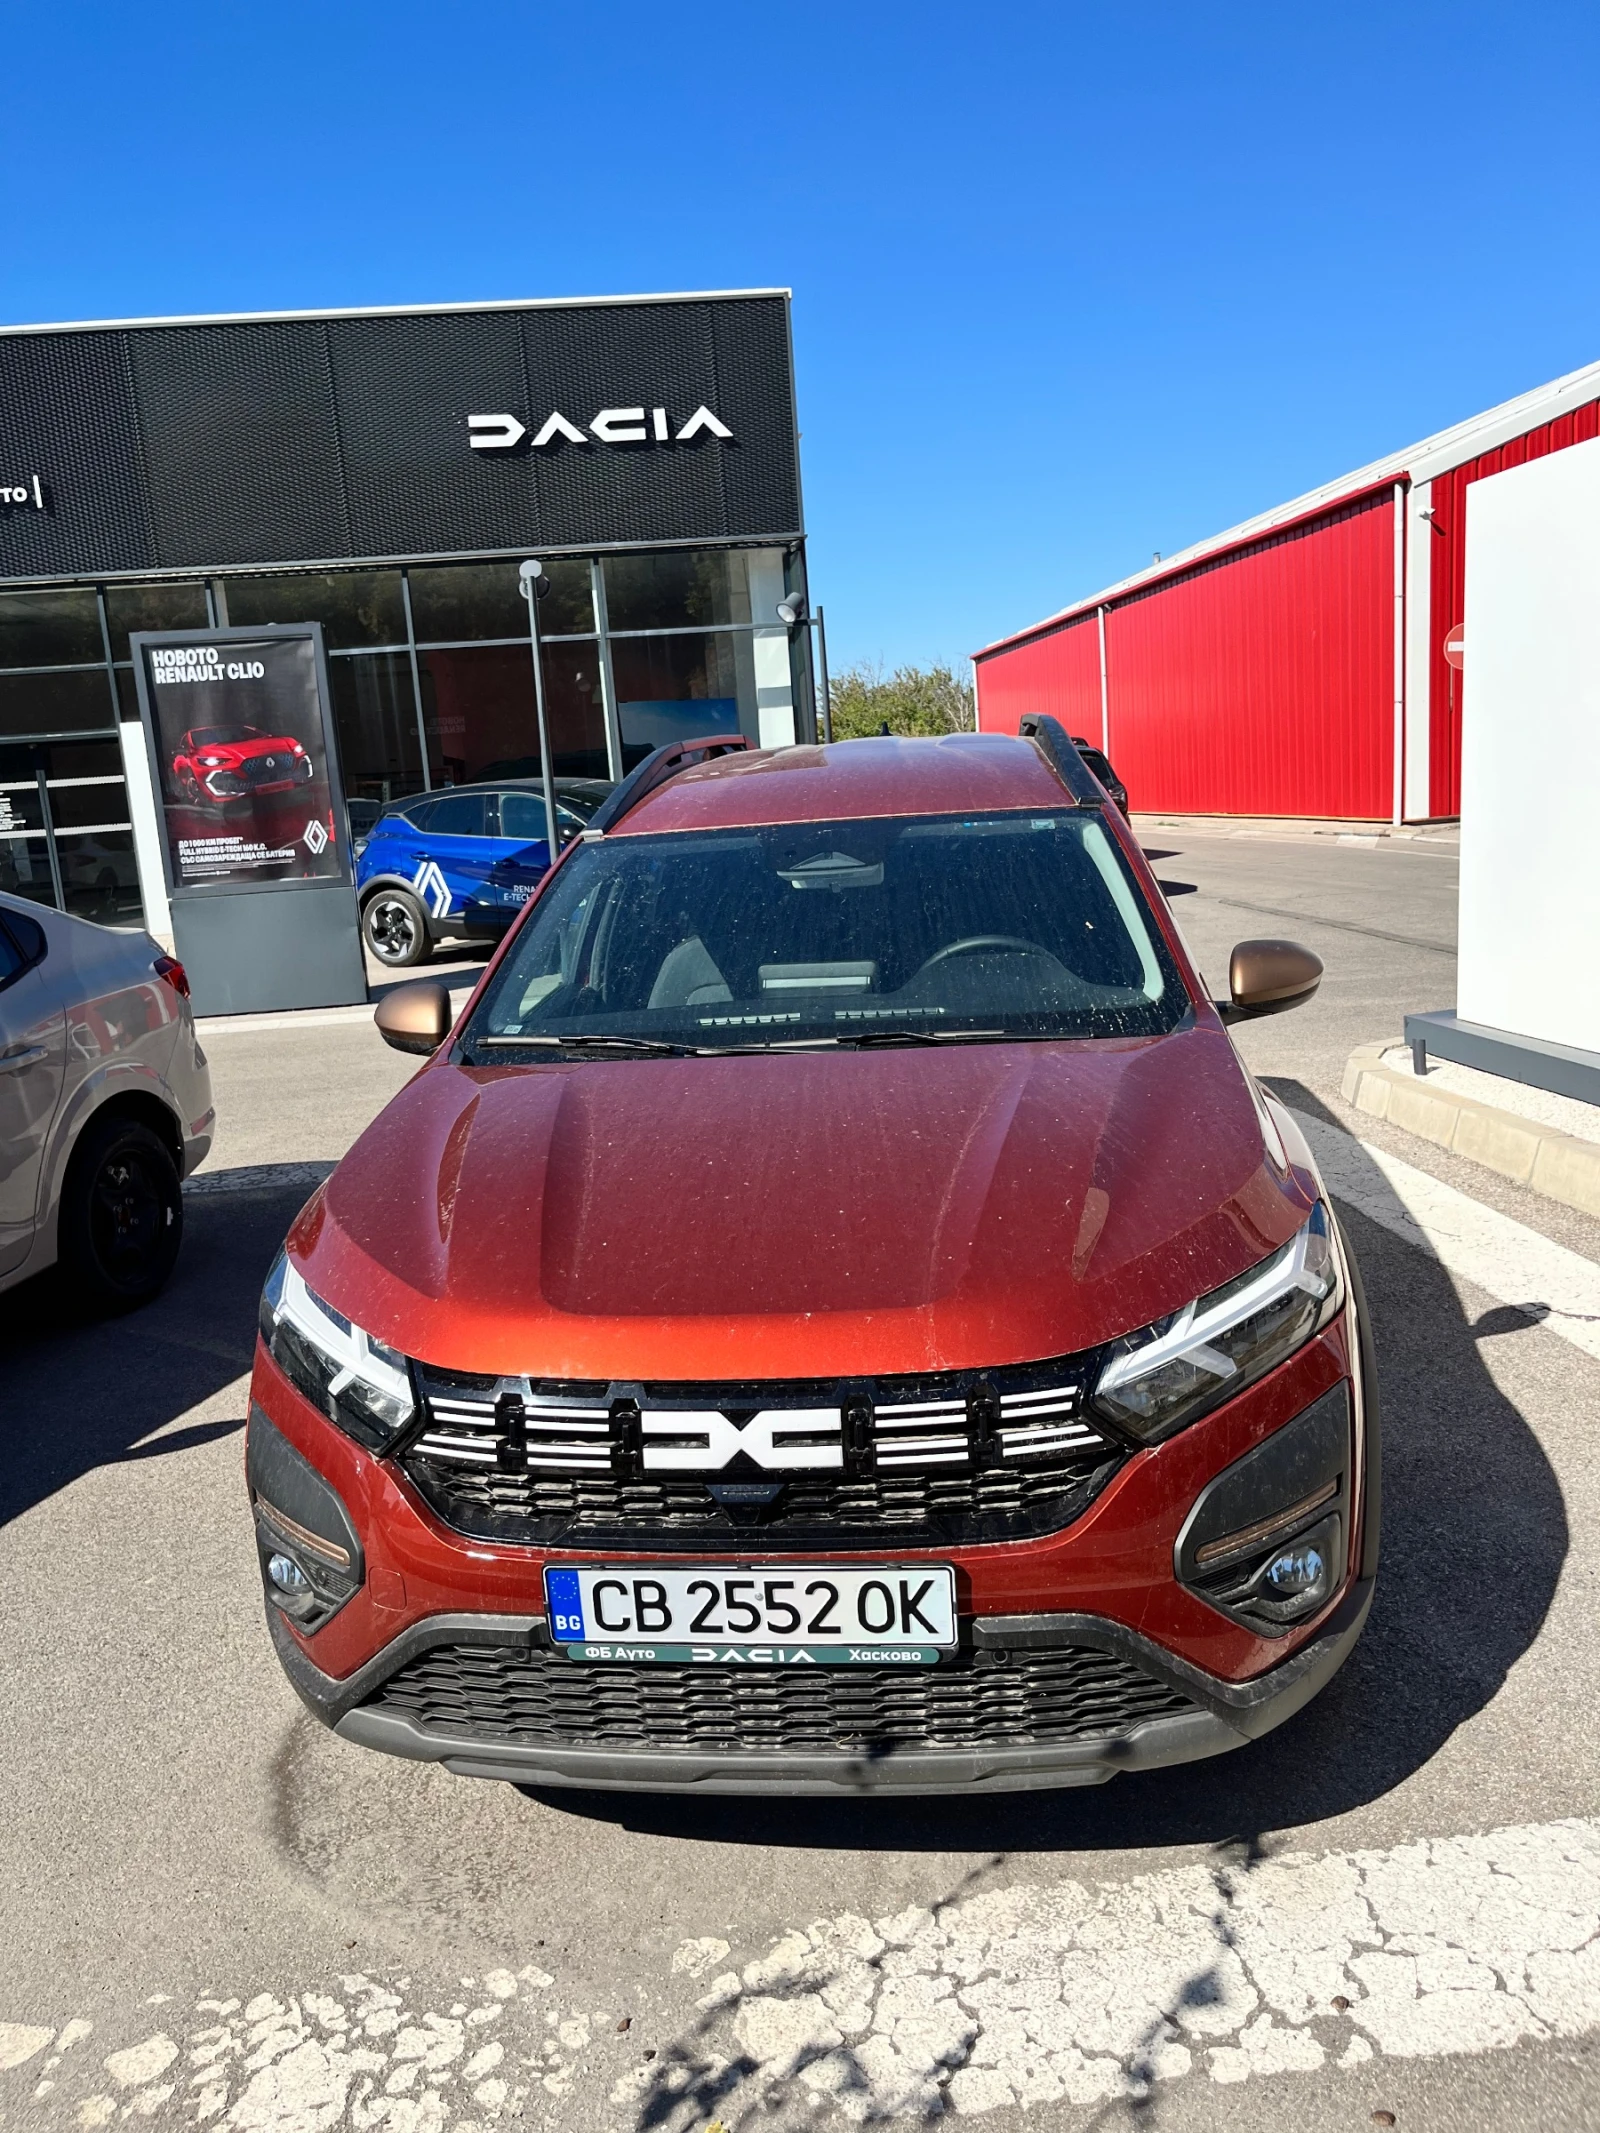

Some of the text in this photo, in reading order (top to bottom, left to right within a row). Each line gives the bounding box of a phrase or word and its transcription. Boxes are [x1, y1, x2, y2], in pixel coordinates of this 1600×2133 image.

[467, 404, 734, 449] DACIA
[152, 647, 219, 668] НОВОТО
[154, 661, 265, 684] RENAULT CLIO
[179, 848, 196, 856] FULL
[196, 846, 220, 855] HYBRID
[220, 845, 243, 854] E-TECH
[686, 1579, 842, 1634] 2552
[555, 1615, 581, 1630] BG
[585, 1646, 655, 1660] ФБ Ауто
[691, 1648, 816, 1662] DACIA
[848, 1649, 922, 1661] Хасково
